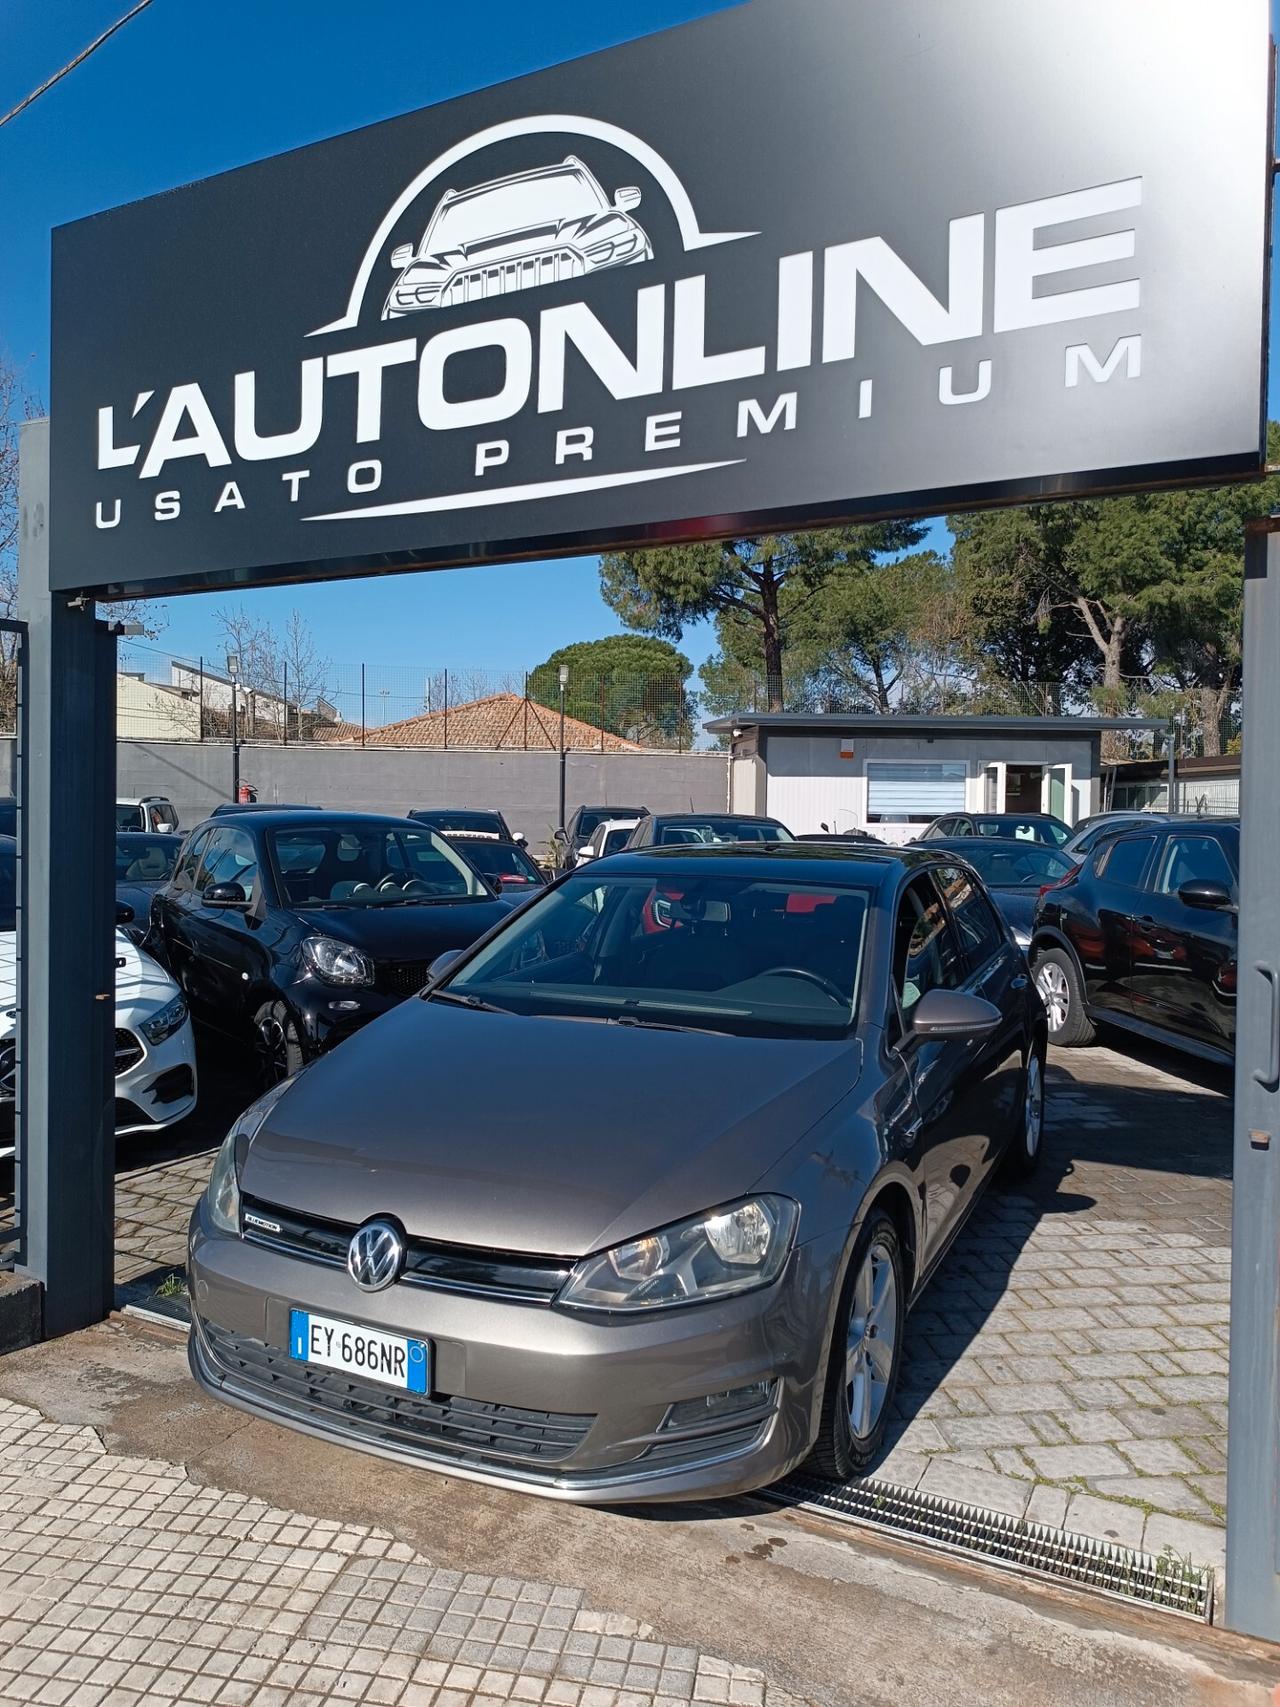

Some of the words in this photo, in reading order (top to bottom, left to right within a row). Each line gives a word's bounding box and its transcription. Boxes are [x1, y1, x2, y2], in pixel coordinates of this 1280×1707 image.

[96, 176, 1143, 479] L'AUTONLINE
[95, 460, 382, 529] USATO
[475, 334, 1142, 477] PREMIUM
[310, 1324, 334, 1357] EY
[341, 1333, 405, 1378] 686NR
